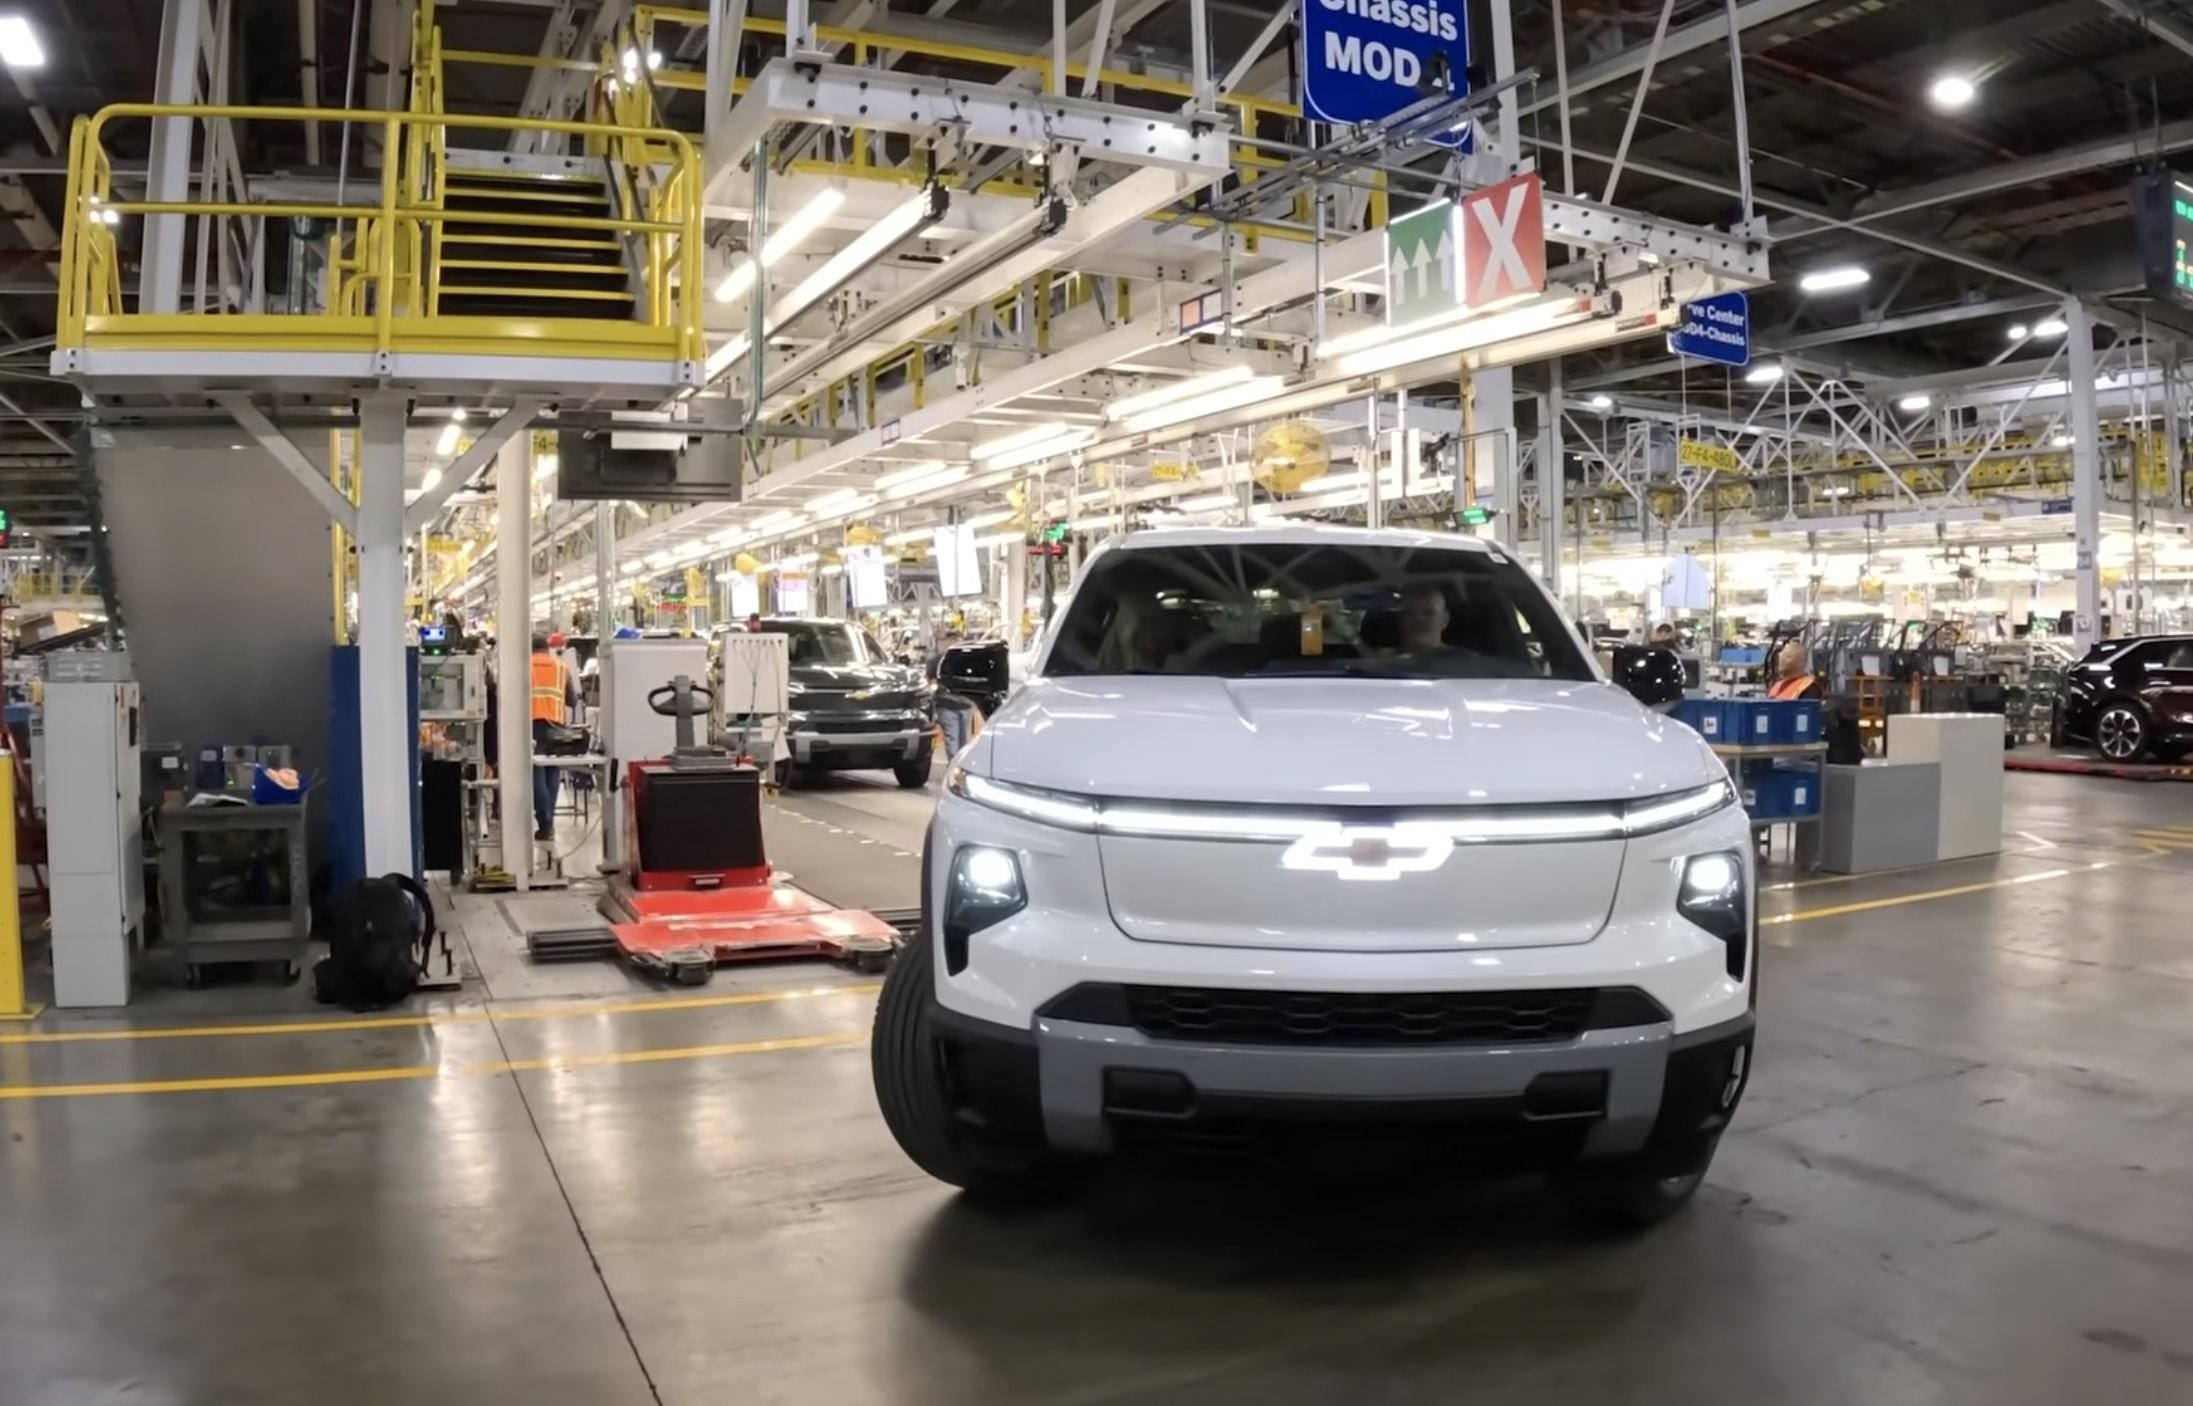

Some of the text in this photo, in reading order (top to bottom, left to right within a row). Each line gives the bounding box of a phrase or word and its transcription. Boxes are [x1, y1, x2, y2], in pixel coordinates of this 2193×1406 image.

[1320, 0, 1458, 41] assis
[1325, 30, 1421, 87] MOD
[1707, 305, 1744, 326] Center
